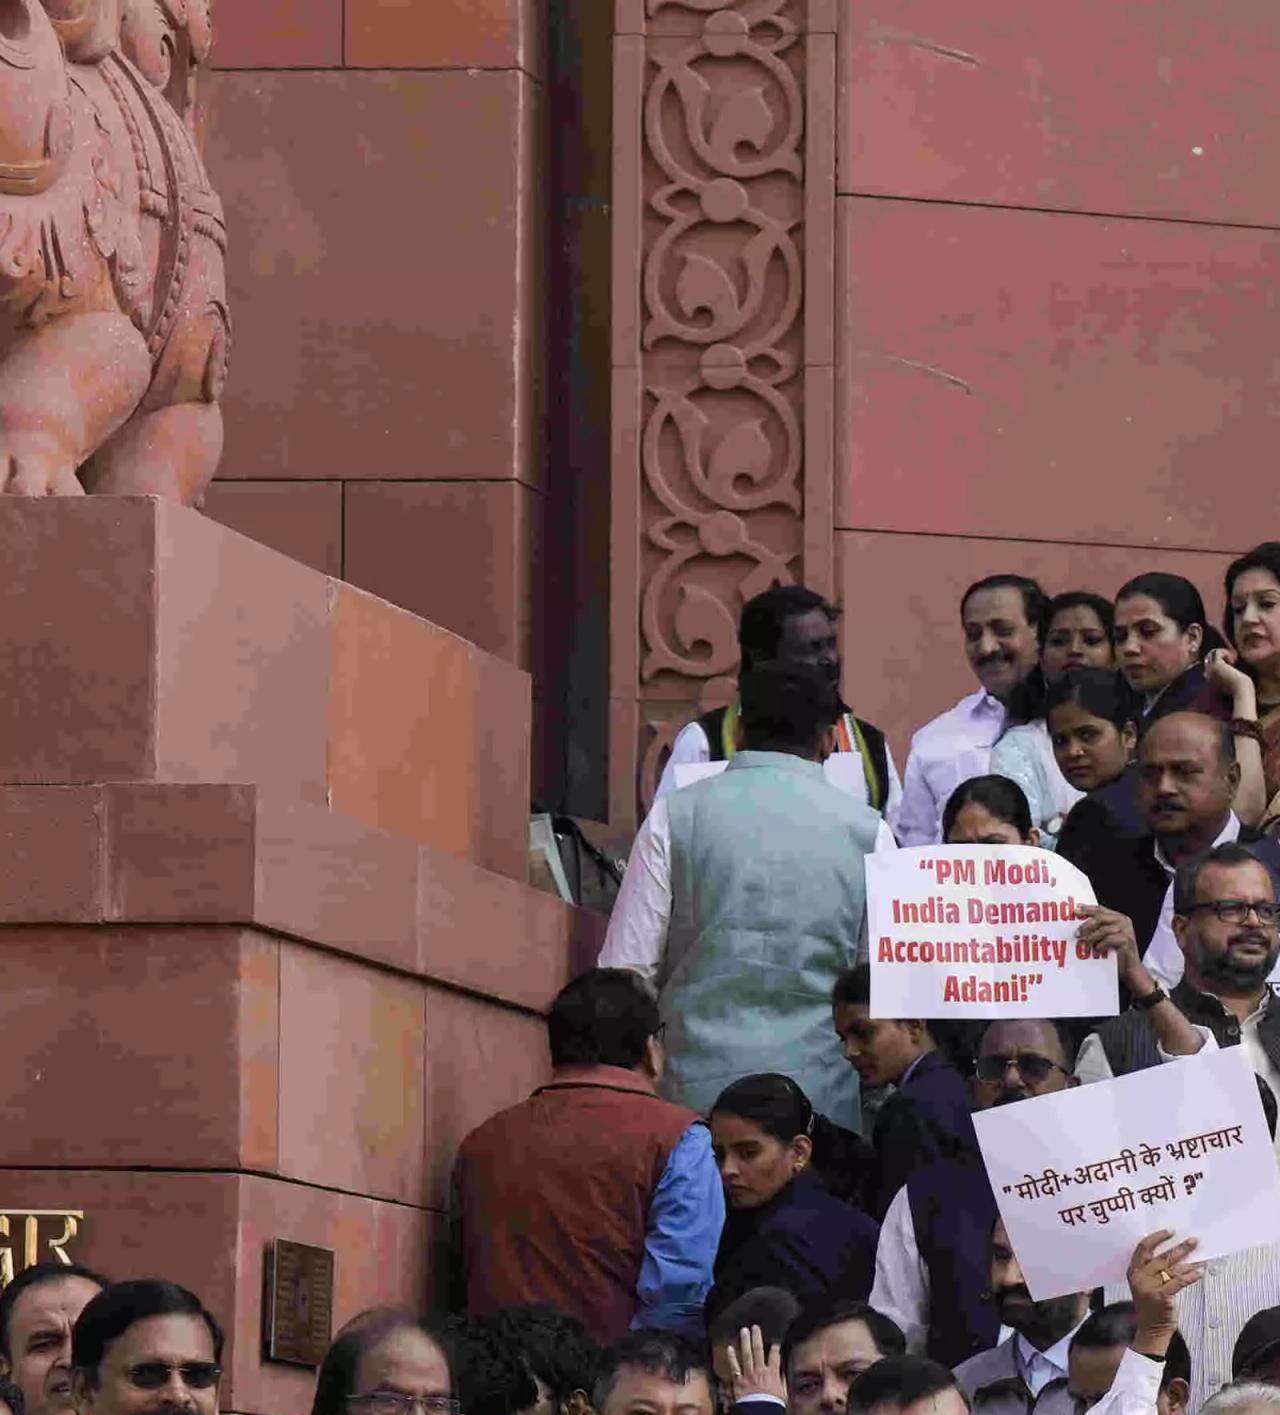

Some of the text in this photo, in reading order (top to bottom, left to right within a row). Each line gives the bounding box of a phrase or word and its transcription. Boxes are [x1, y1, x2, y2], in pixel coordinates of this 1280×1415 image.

[919, 858, 1057, 888] “PM Modi,
[892, 896, 960, 924] India
[877, 934, 1067, 968] Accountability
[943, 973, 1043, 1003] Adani!”
[1140, 1143, 1161, 1168] के
[1166, 1124, 1244, 1162] भ्रष्टाचार
[1058, 1204, 1086, 1227] पर
[1089, 1190, 1137, 1225] चुप्पी
[1138, 1176, 1176, 1205] क्यों
